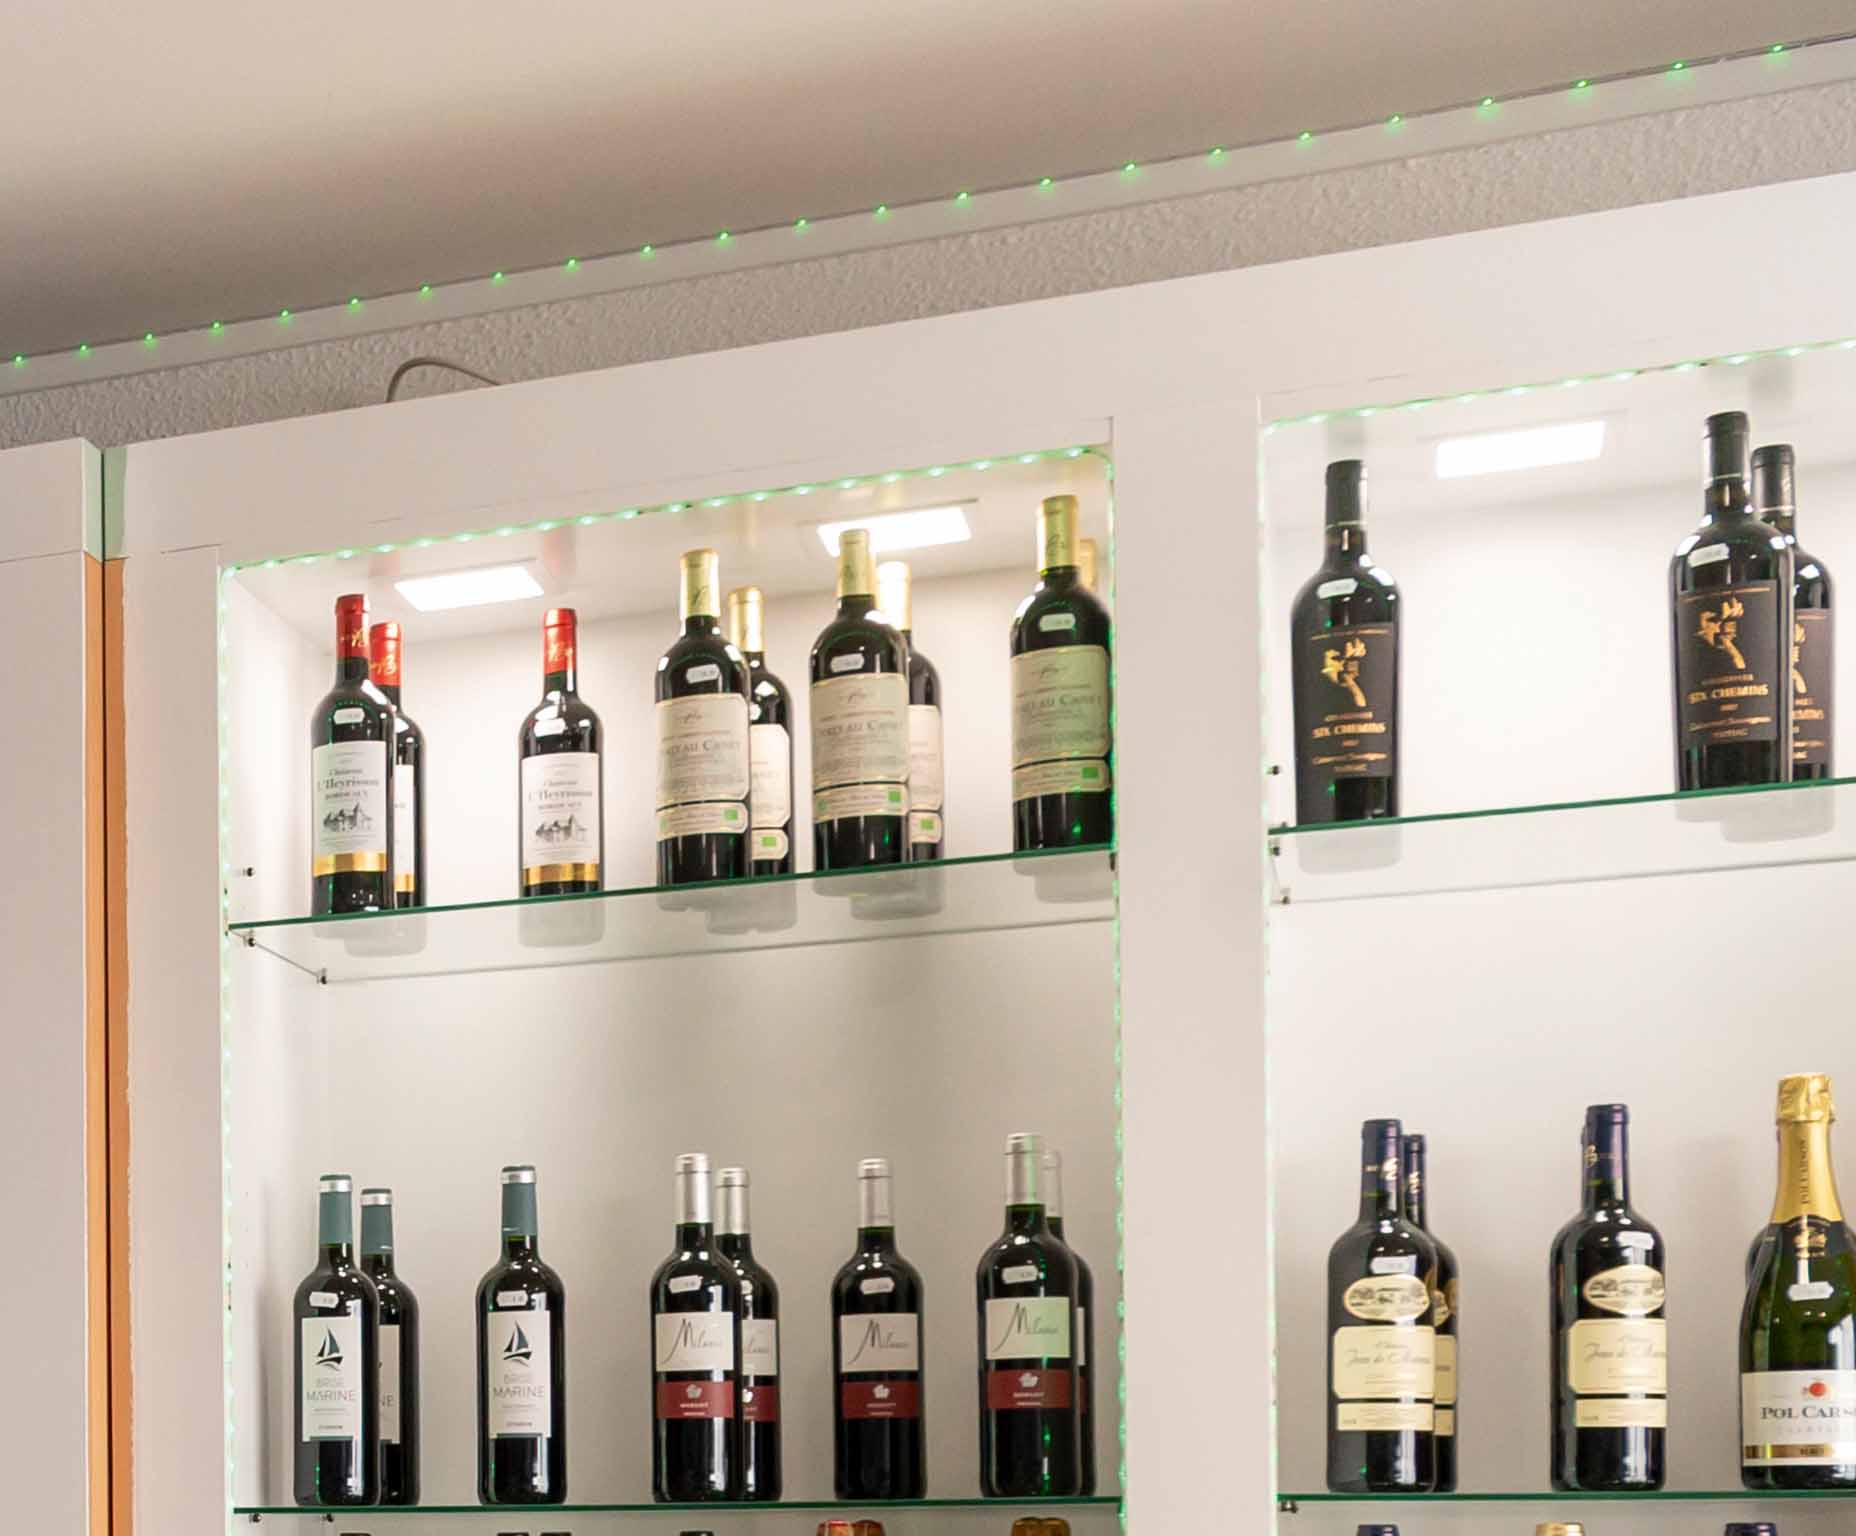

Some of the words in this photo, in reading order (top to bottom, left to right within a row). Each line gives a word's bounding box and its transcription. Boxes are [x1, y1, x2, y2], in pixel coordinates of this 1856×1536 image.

[306, 1389, 356, 1403] MARINE
[492, 1384, 547, 1399] MARINE
[1760, 1404, 1796, 1421] POL
